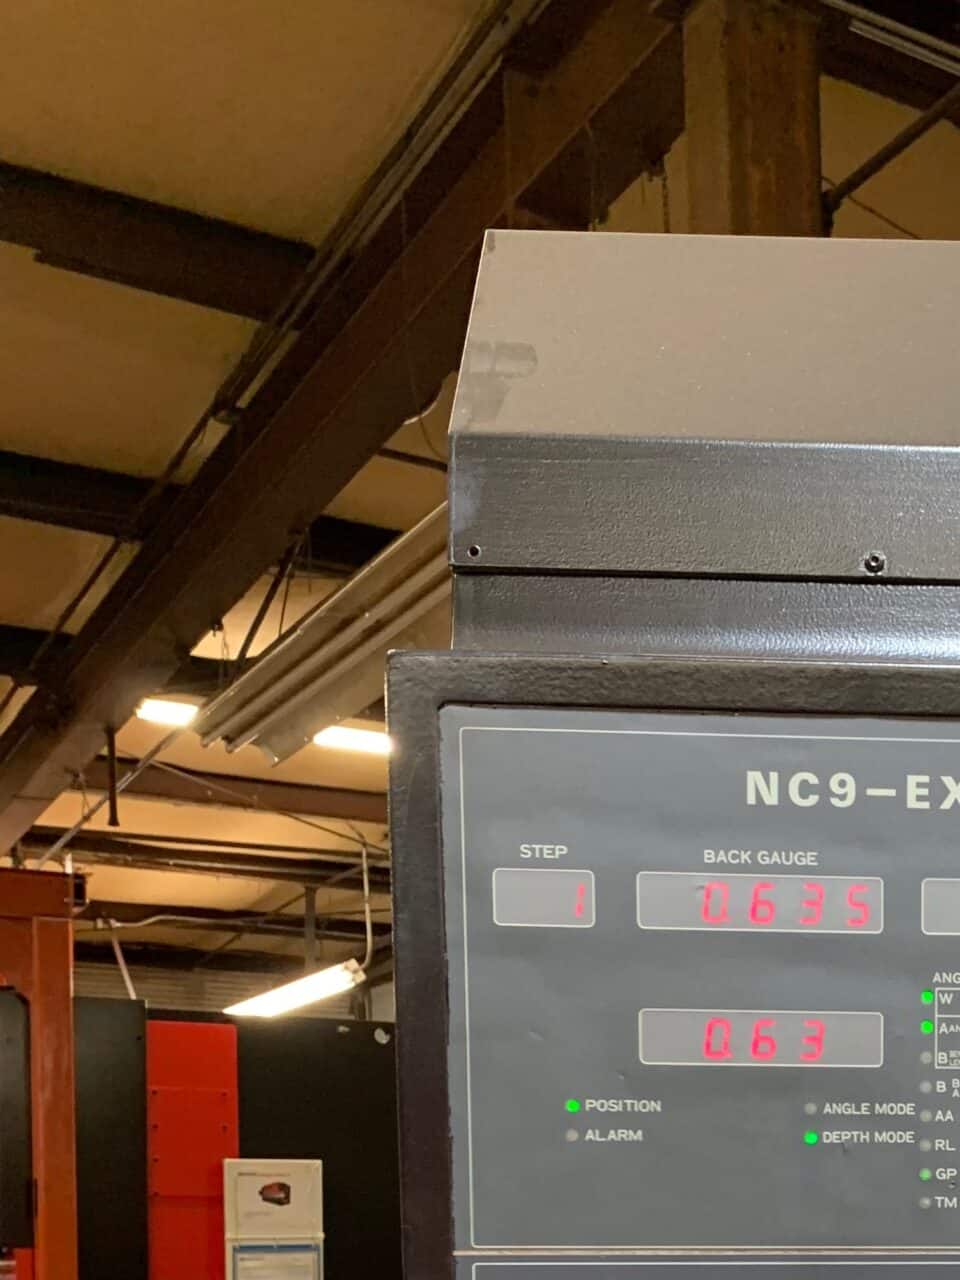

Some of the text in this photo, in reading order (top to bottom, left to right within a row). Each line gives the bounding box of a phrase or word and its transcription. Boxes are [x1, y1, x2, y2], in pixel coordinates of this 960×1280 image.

[519, 844, 568, 860] STEP
[703, 850, 818, 866] BACK GAUGE
[574, 883, 587, 918] 1
[939, 993, 953, 1005] W
[939, 1023, 949, 1034] A
[938, 1052, 948, 1064] B
[936, 1081, 947, 1093] B
[585, 1099, 662, 1112] POSITION
[823, 1103, 916, 1115] ANGLE MODE
[935, 1111, 954, 1122] AA
[585, 1129, 643, 1141] ALARM
[822, 1131, 915, 1143] DEPTH MODE
[935, 1139, 956, 1151] RL
[935, 1168, 957, 1180] GP
[935, 1196, 957, 1208] TM
